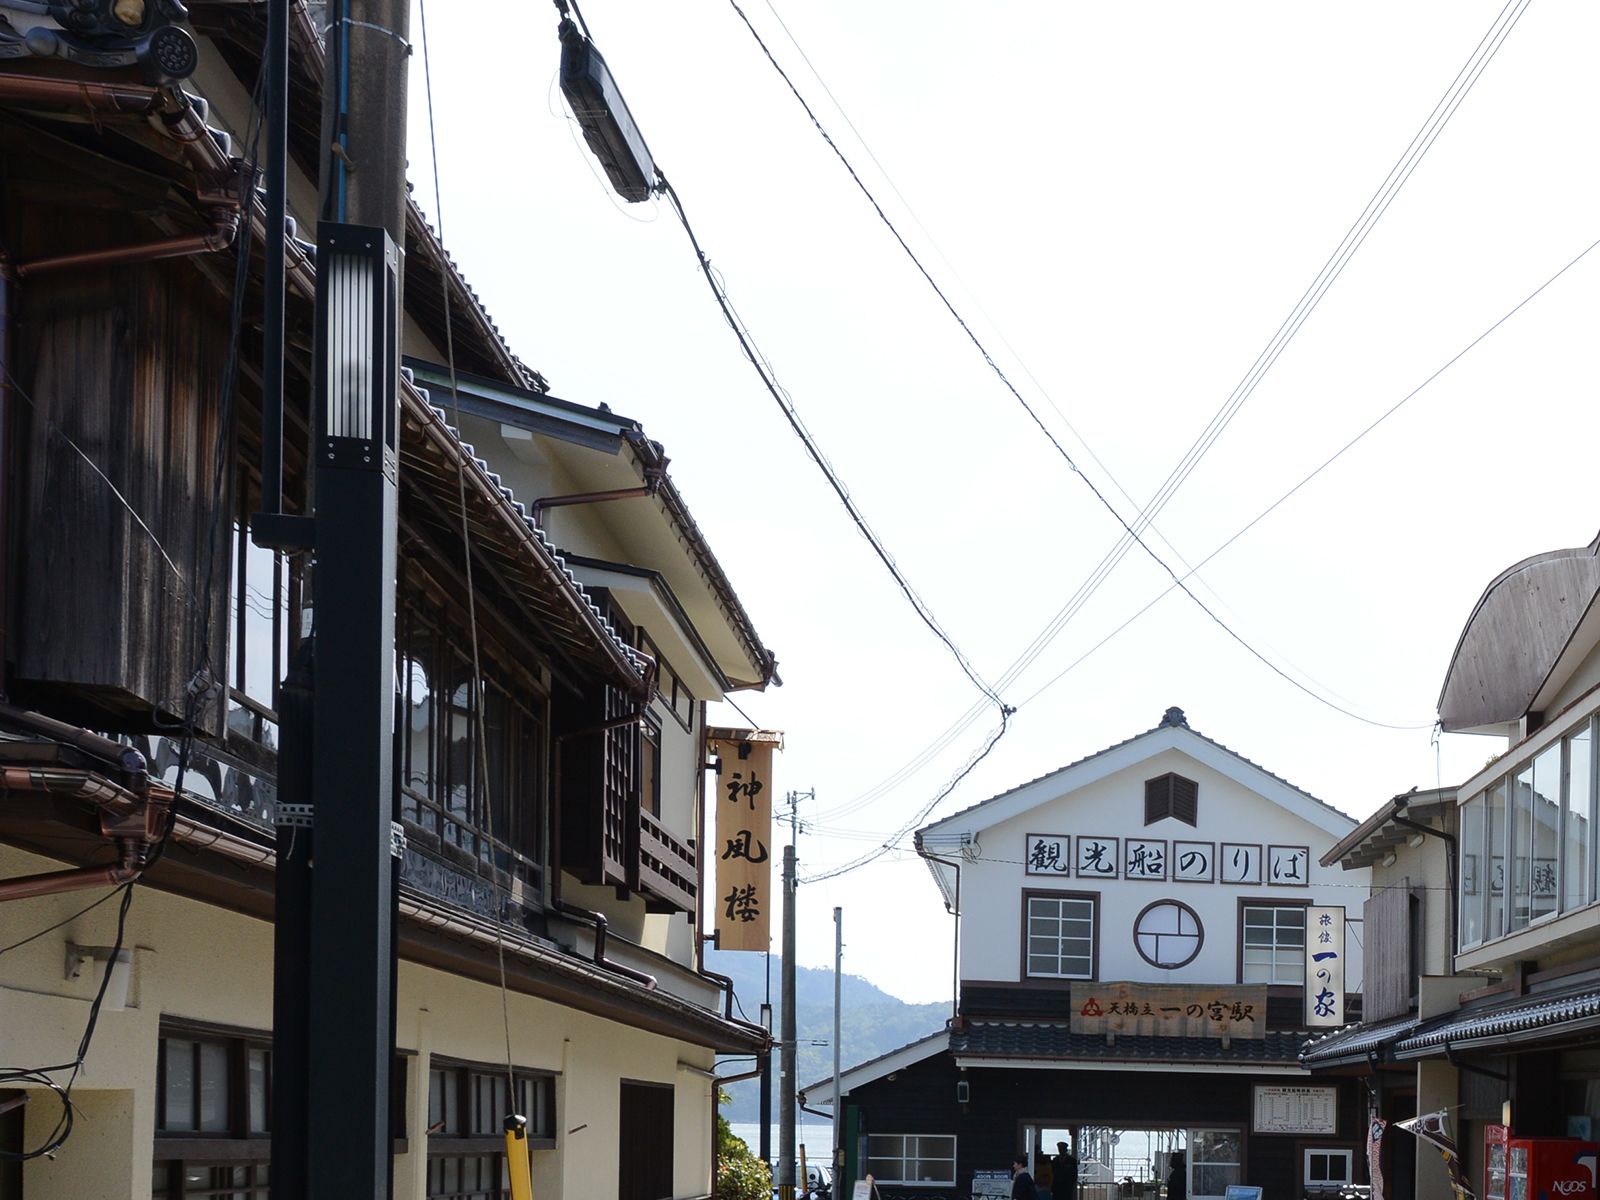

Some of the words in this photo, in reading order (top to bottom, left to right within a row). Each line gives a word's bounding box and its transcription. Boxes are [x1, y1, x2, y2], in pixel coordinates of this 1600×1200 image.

[721, 770, 768, 923] 神風楼
[1028, 838, 1308, 882] 観光船のりば
